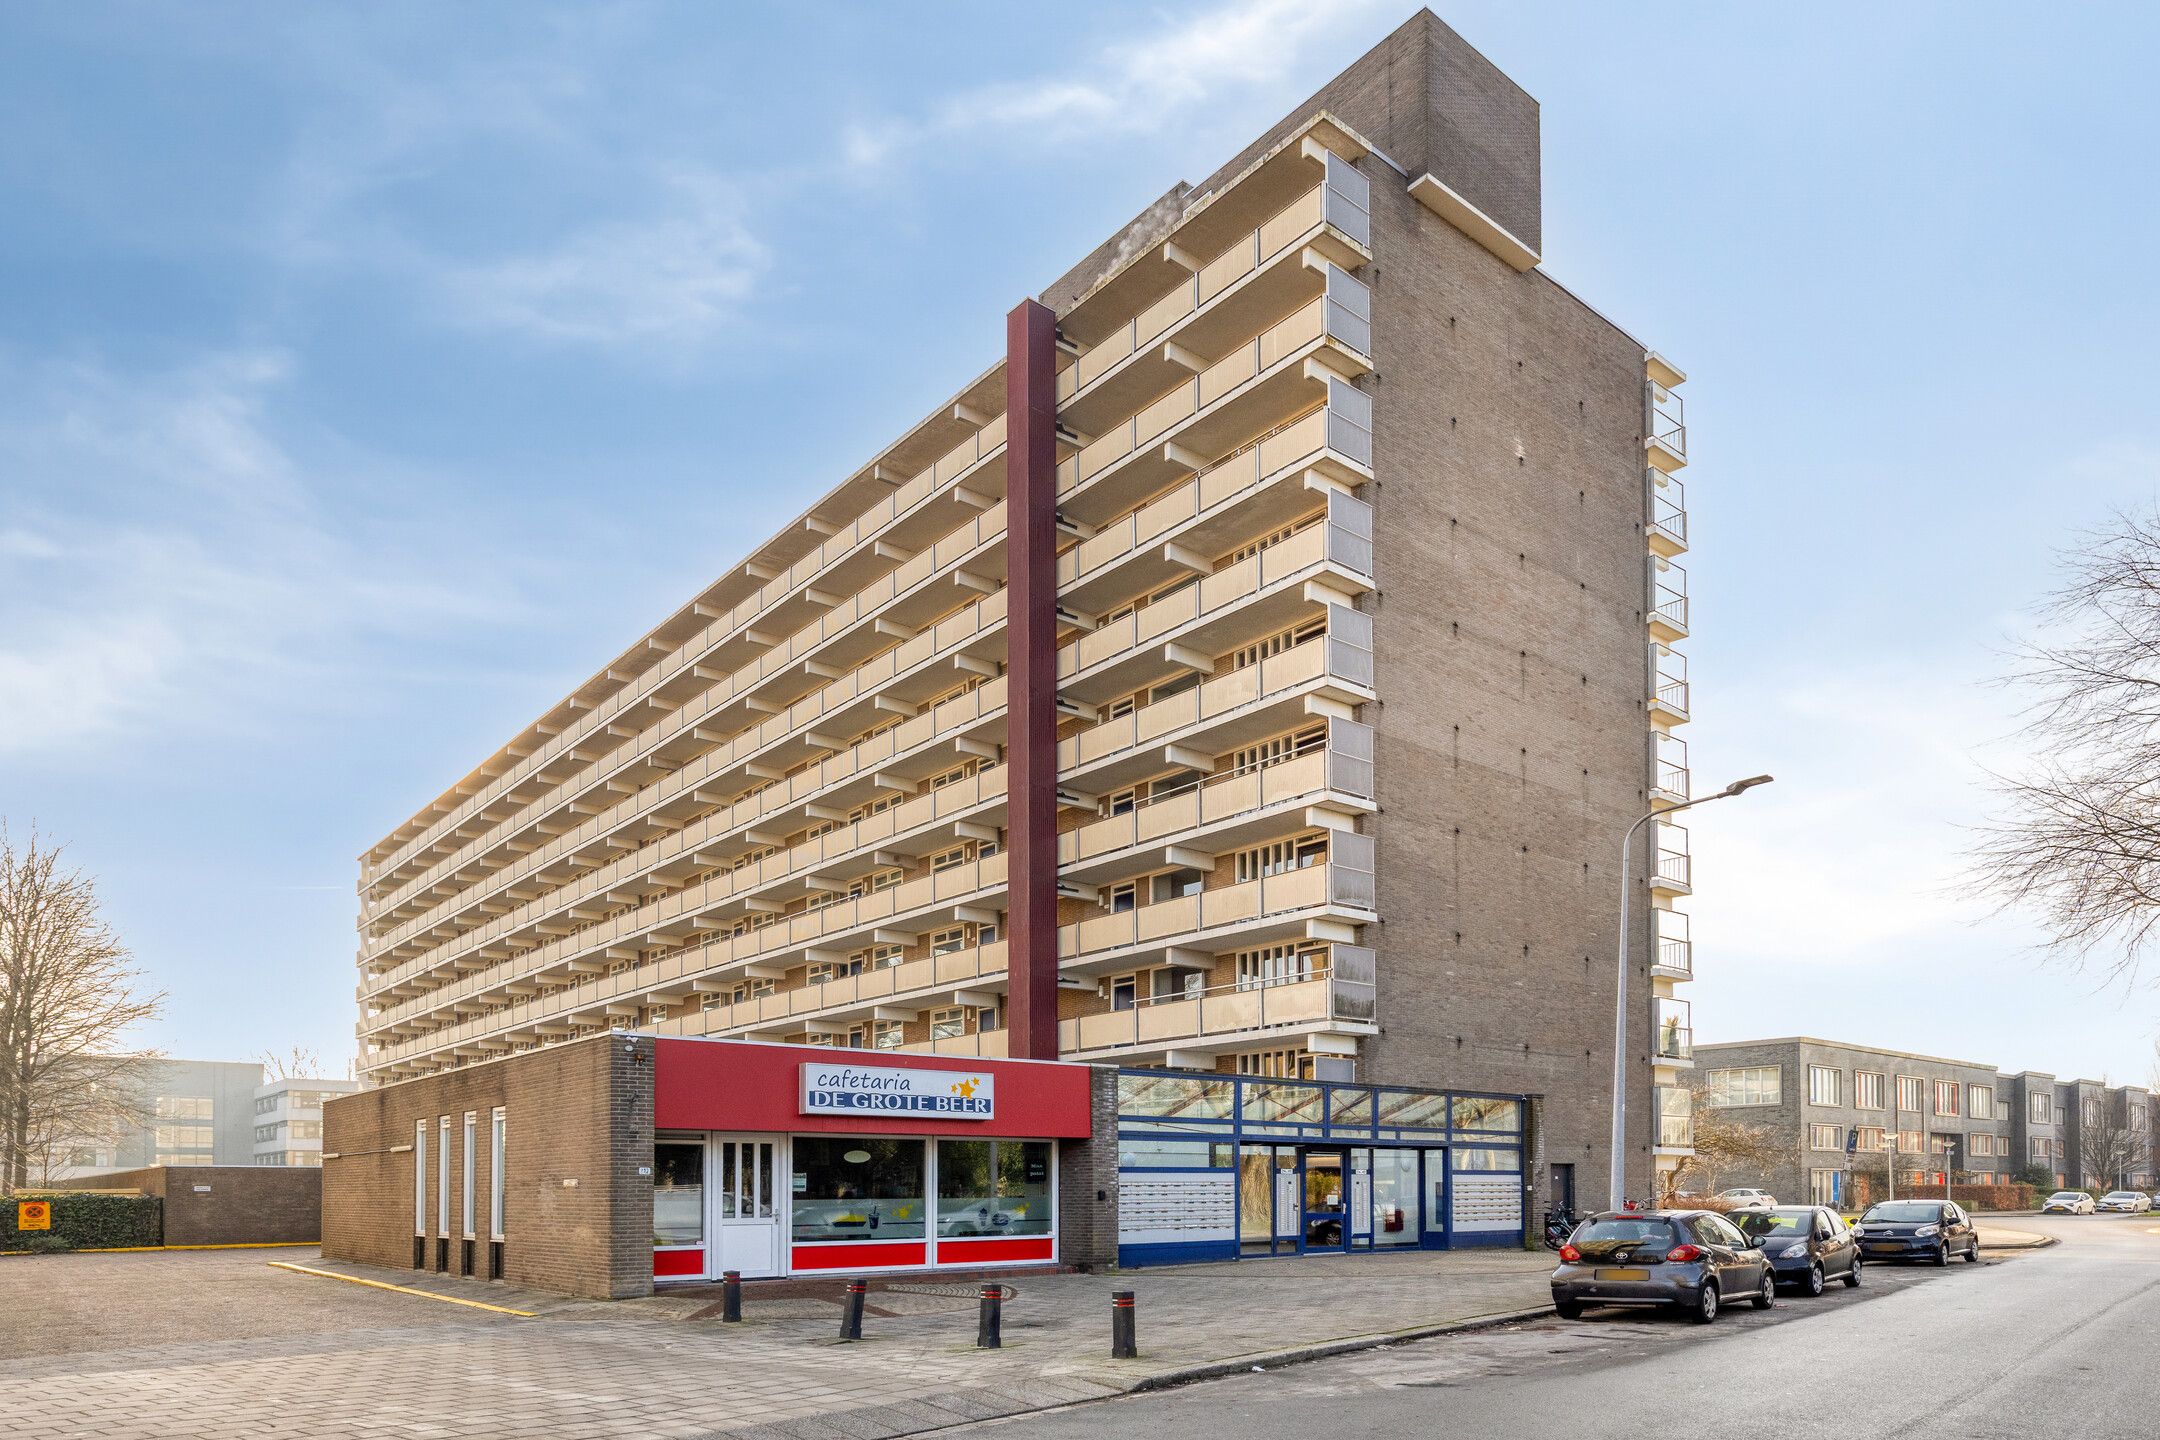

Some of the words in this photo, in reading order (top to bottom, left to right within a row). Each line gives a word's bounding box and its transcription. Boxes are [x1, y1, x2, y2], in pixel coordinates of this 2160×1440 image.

[817, 1069, 911, 1091] cafetaria
[814, 1091, 845, 1107] DE
[852, 1092, 930, 1111] GROTE
[936, 1096, 988, 1113] BEER
